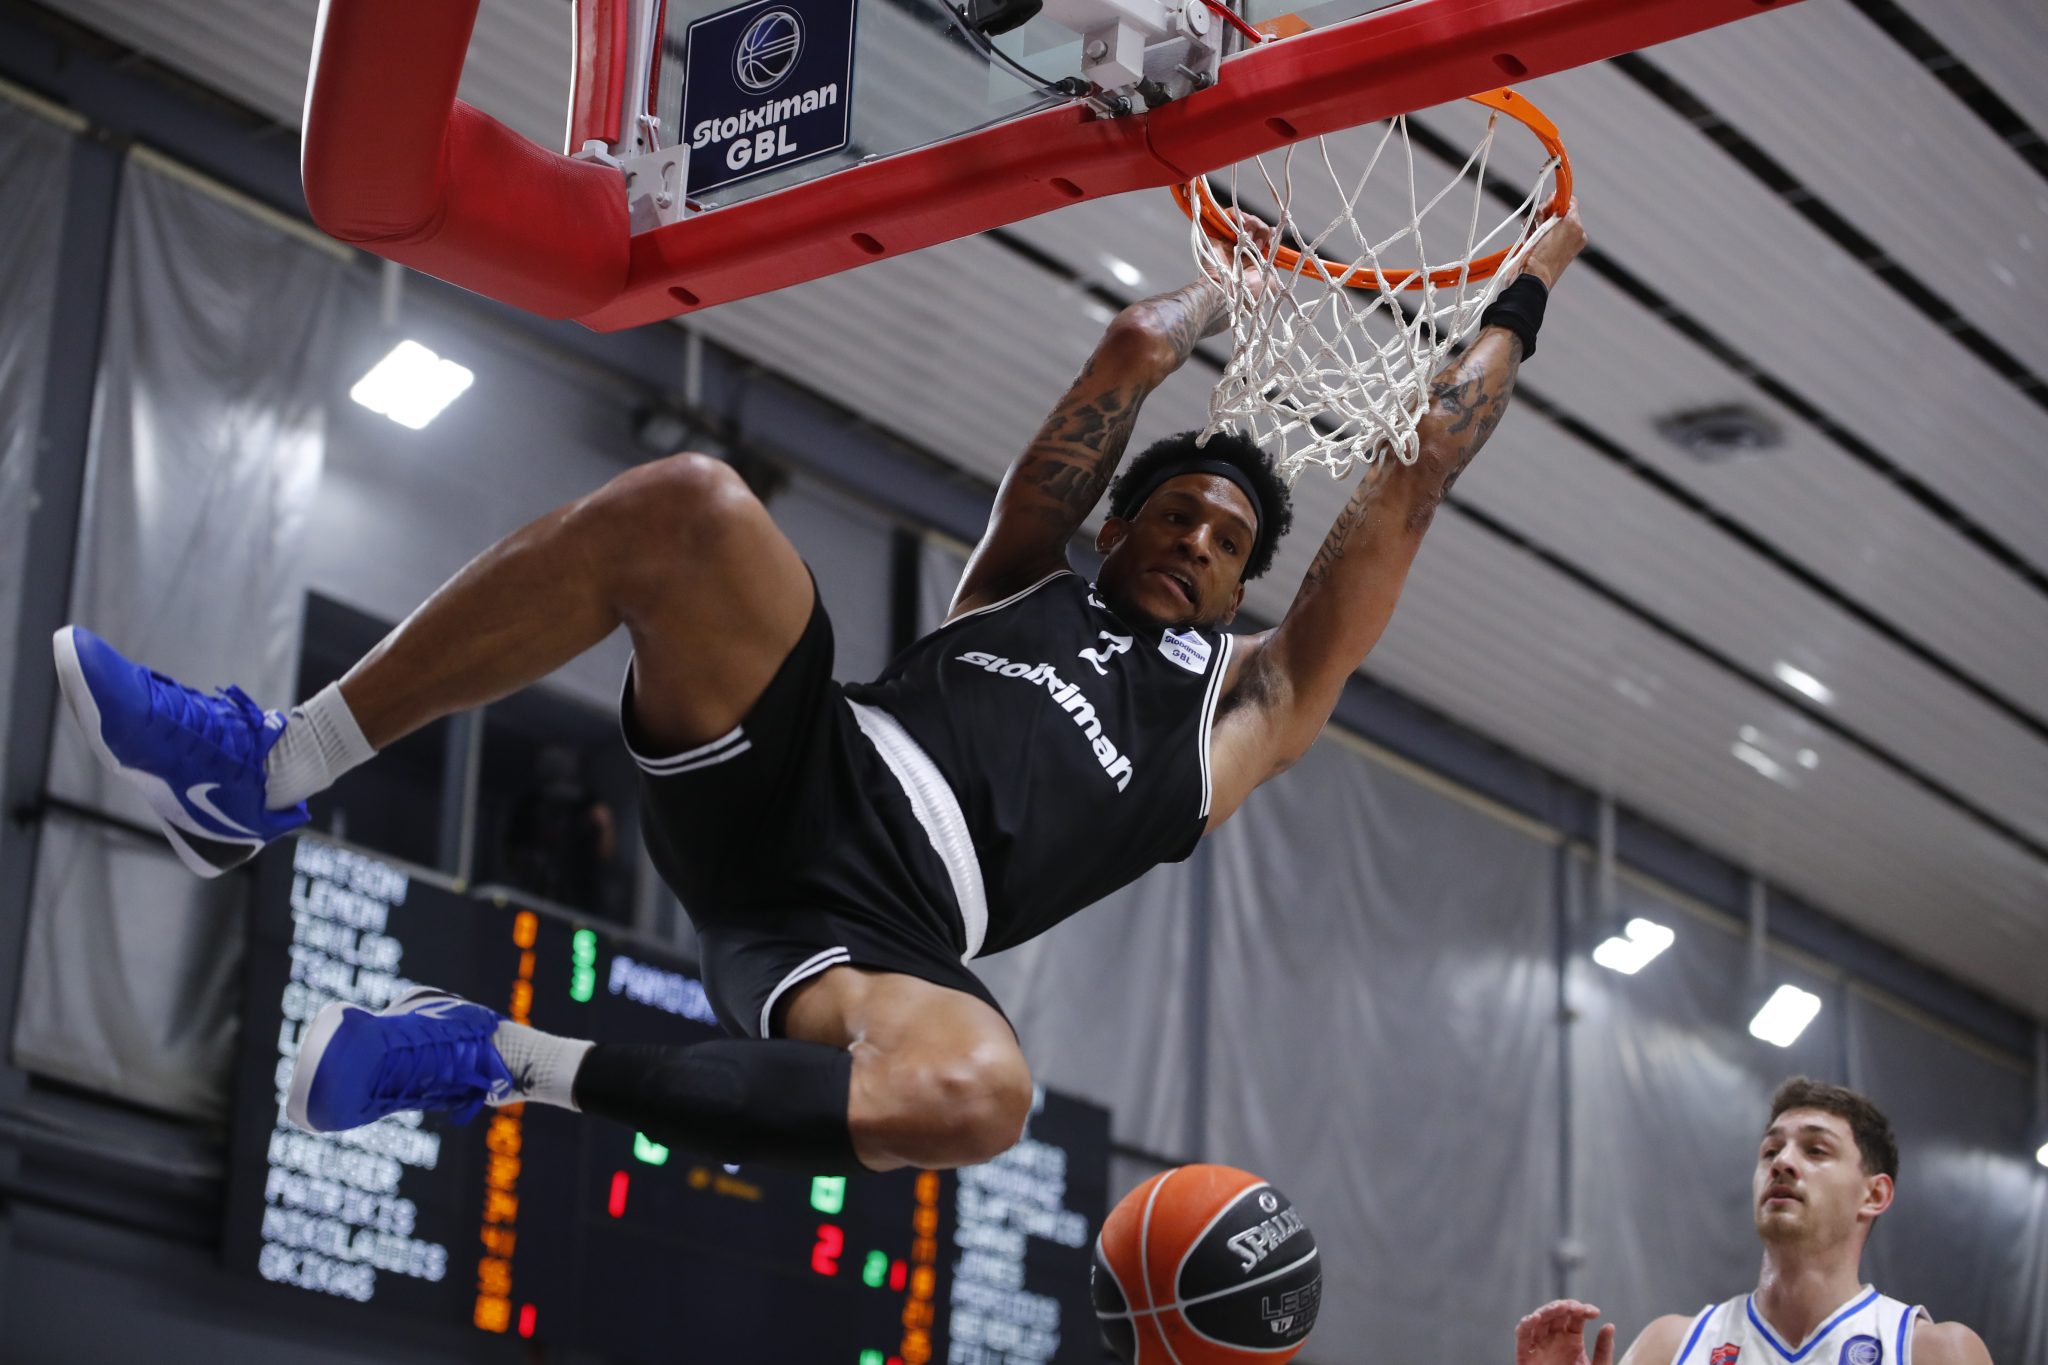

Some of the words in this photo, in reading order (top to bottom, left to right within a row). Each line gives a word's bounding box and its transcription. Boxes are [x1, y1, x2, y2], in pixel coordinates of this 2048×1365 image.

[693, 83, 838, 150] Stoiximan
[726, 125, 797, 171] GBL
[1172, 649, 1192, 665] GBL
